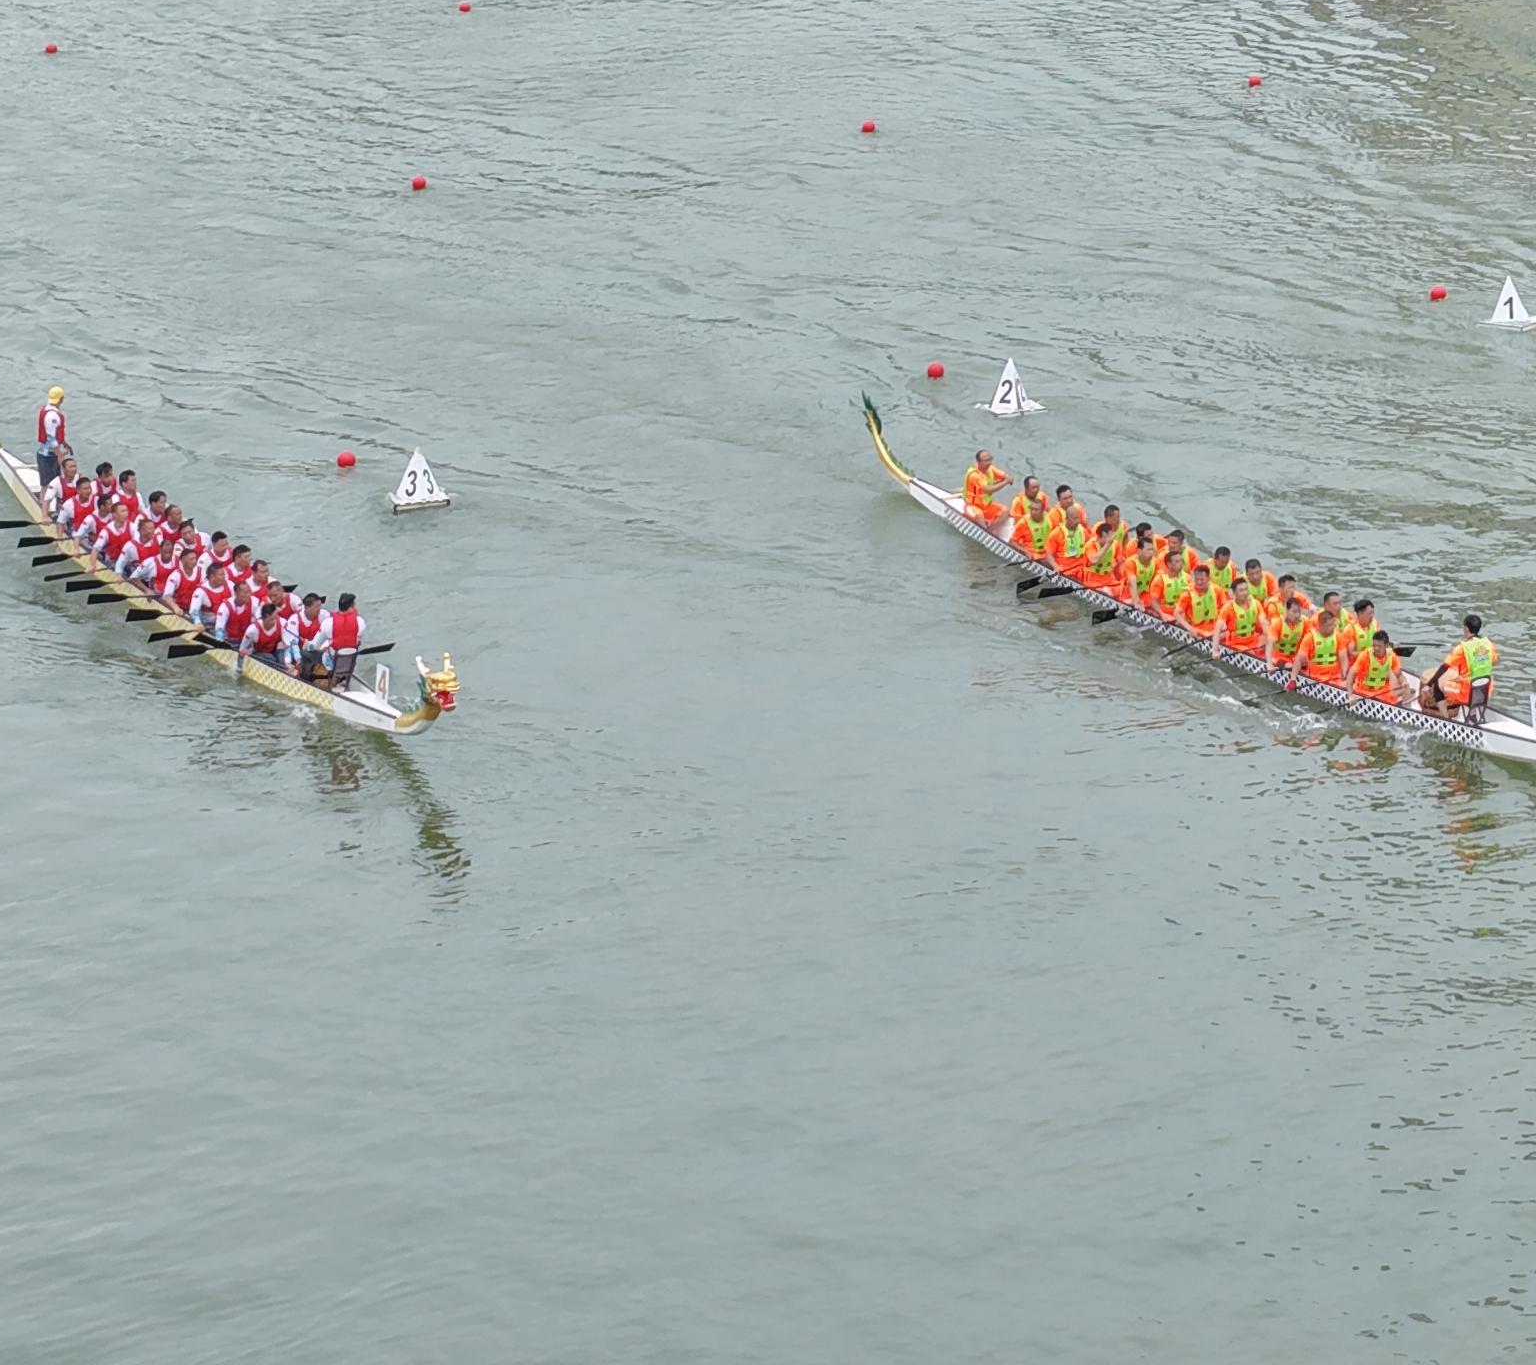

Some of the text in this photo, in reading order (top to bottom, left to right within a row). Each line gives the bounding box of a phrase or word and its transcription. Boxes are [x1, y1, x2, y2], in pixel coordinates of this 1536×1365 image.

[1503, 296, 1514, 320] 1
[998, 379, 1013, 404] 2
[404, 470, 418, 497] 3
[422, 469, 435, 495] 3
[378, 669, 387, 699] 4
